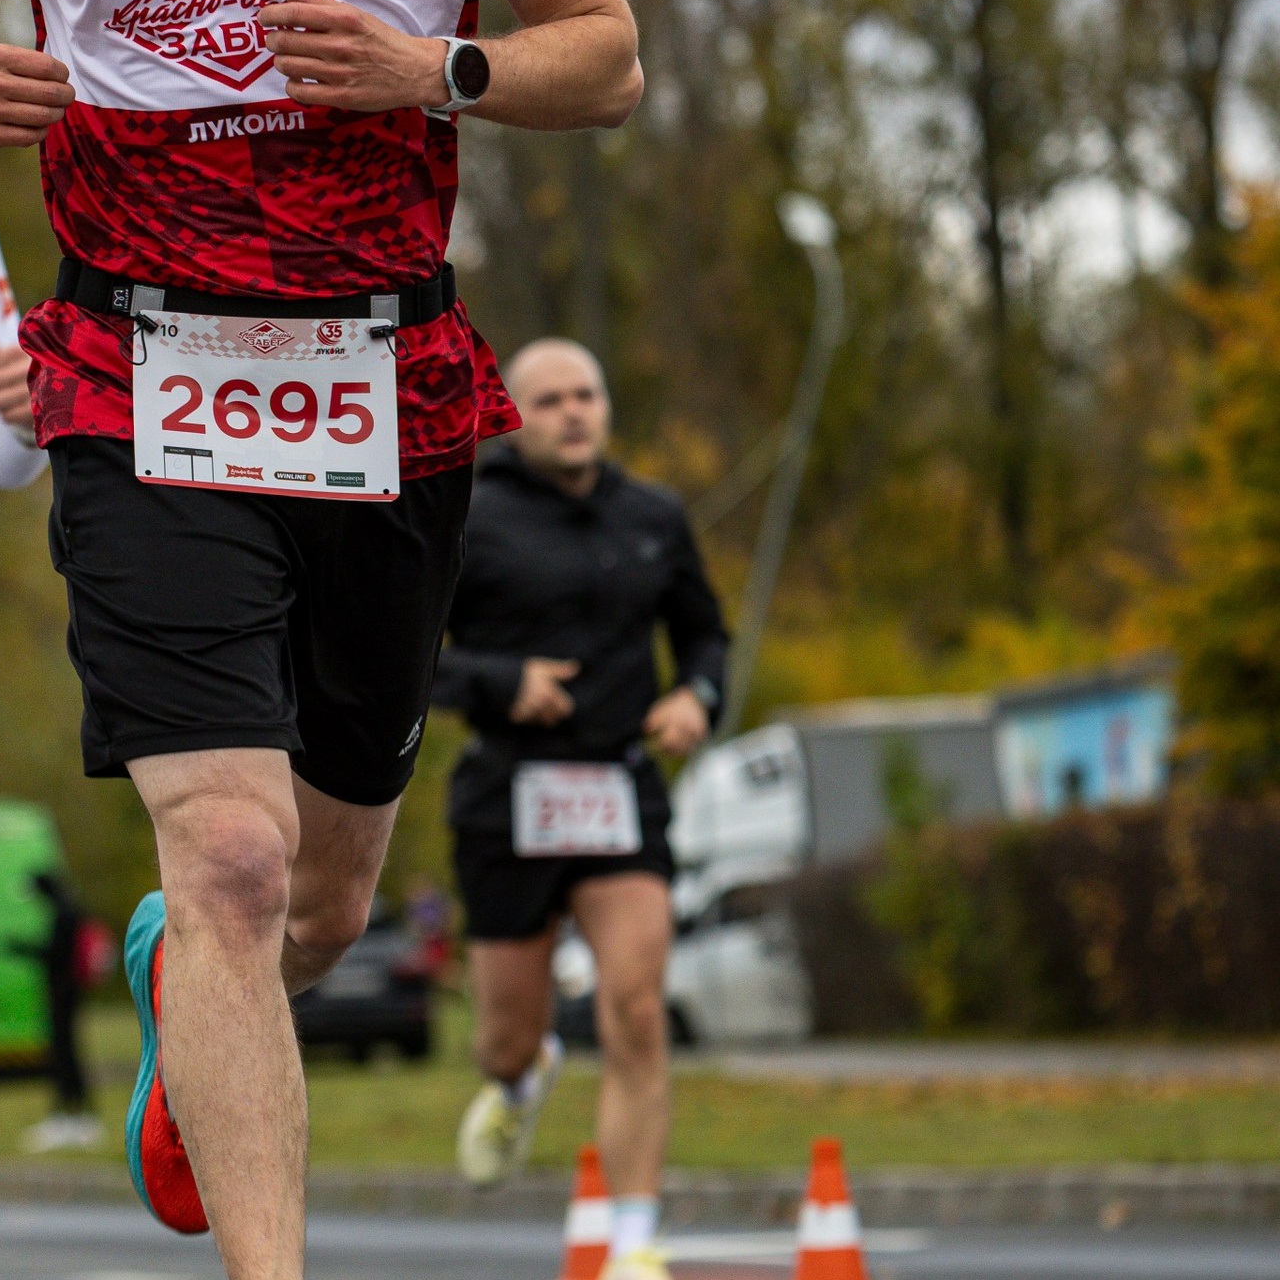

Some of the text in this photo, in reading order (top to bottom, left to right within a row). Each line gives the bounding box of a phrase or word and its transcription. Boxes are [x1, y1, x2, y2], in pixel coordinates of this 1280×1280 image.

[188, 109, 306, 144] ЛУКОЙЛ
[160, 324, 179, 337] 10
[325, 324, 343, 338] 35
[248, 338, 282, 347] ЗАБЕГ
[158, 374, 375, 445] 2695
[276, 472, 307, 481] WINLINE
